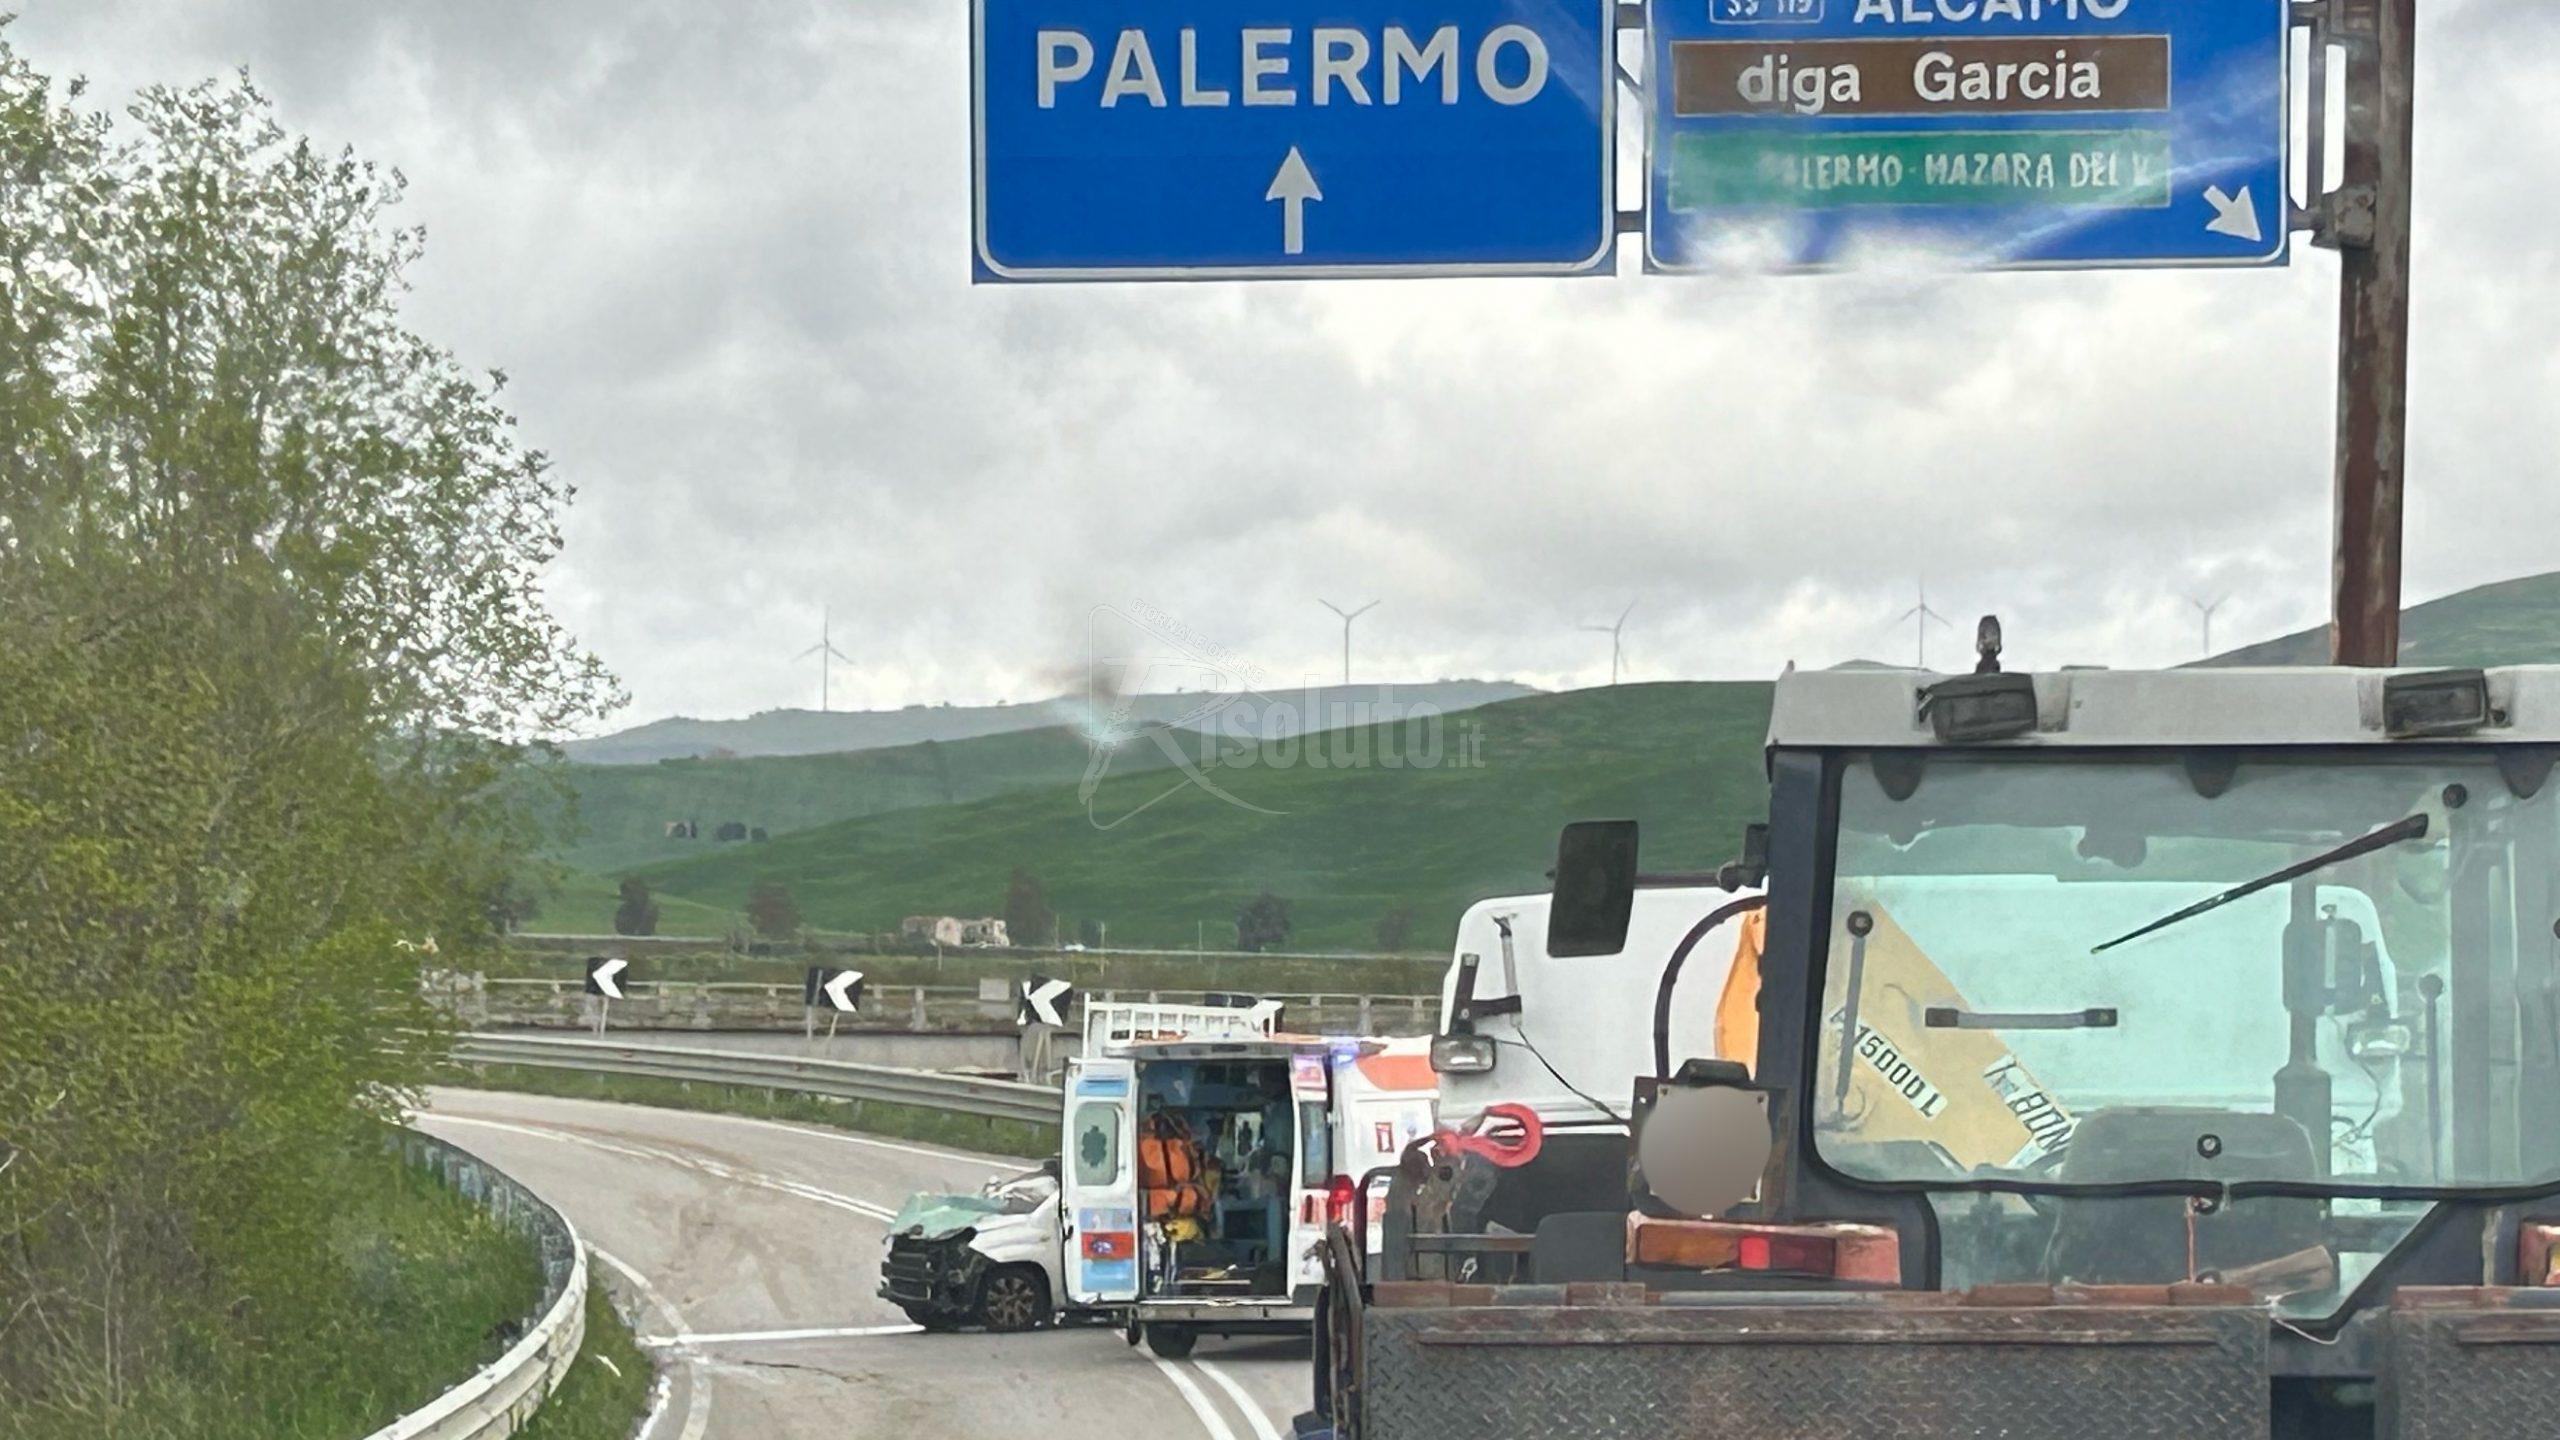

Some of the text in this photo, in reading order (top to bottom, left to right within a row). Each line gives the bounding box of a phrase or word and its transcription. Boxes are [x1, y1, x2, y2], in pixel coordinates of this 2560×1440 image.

[1036, 23, 1551, 109] PALERMO
[1735, 48, 2102, 116] diga Garcia
[1924, 152, 2055, 189] MAZARA
[2069, 151, 2120, 188] DEL
